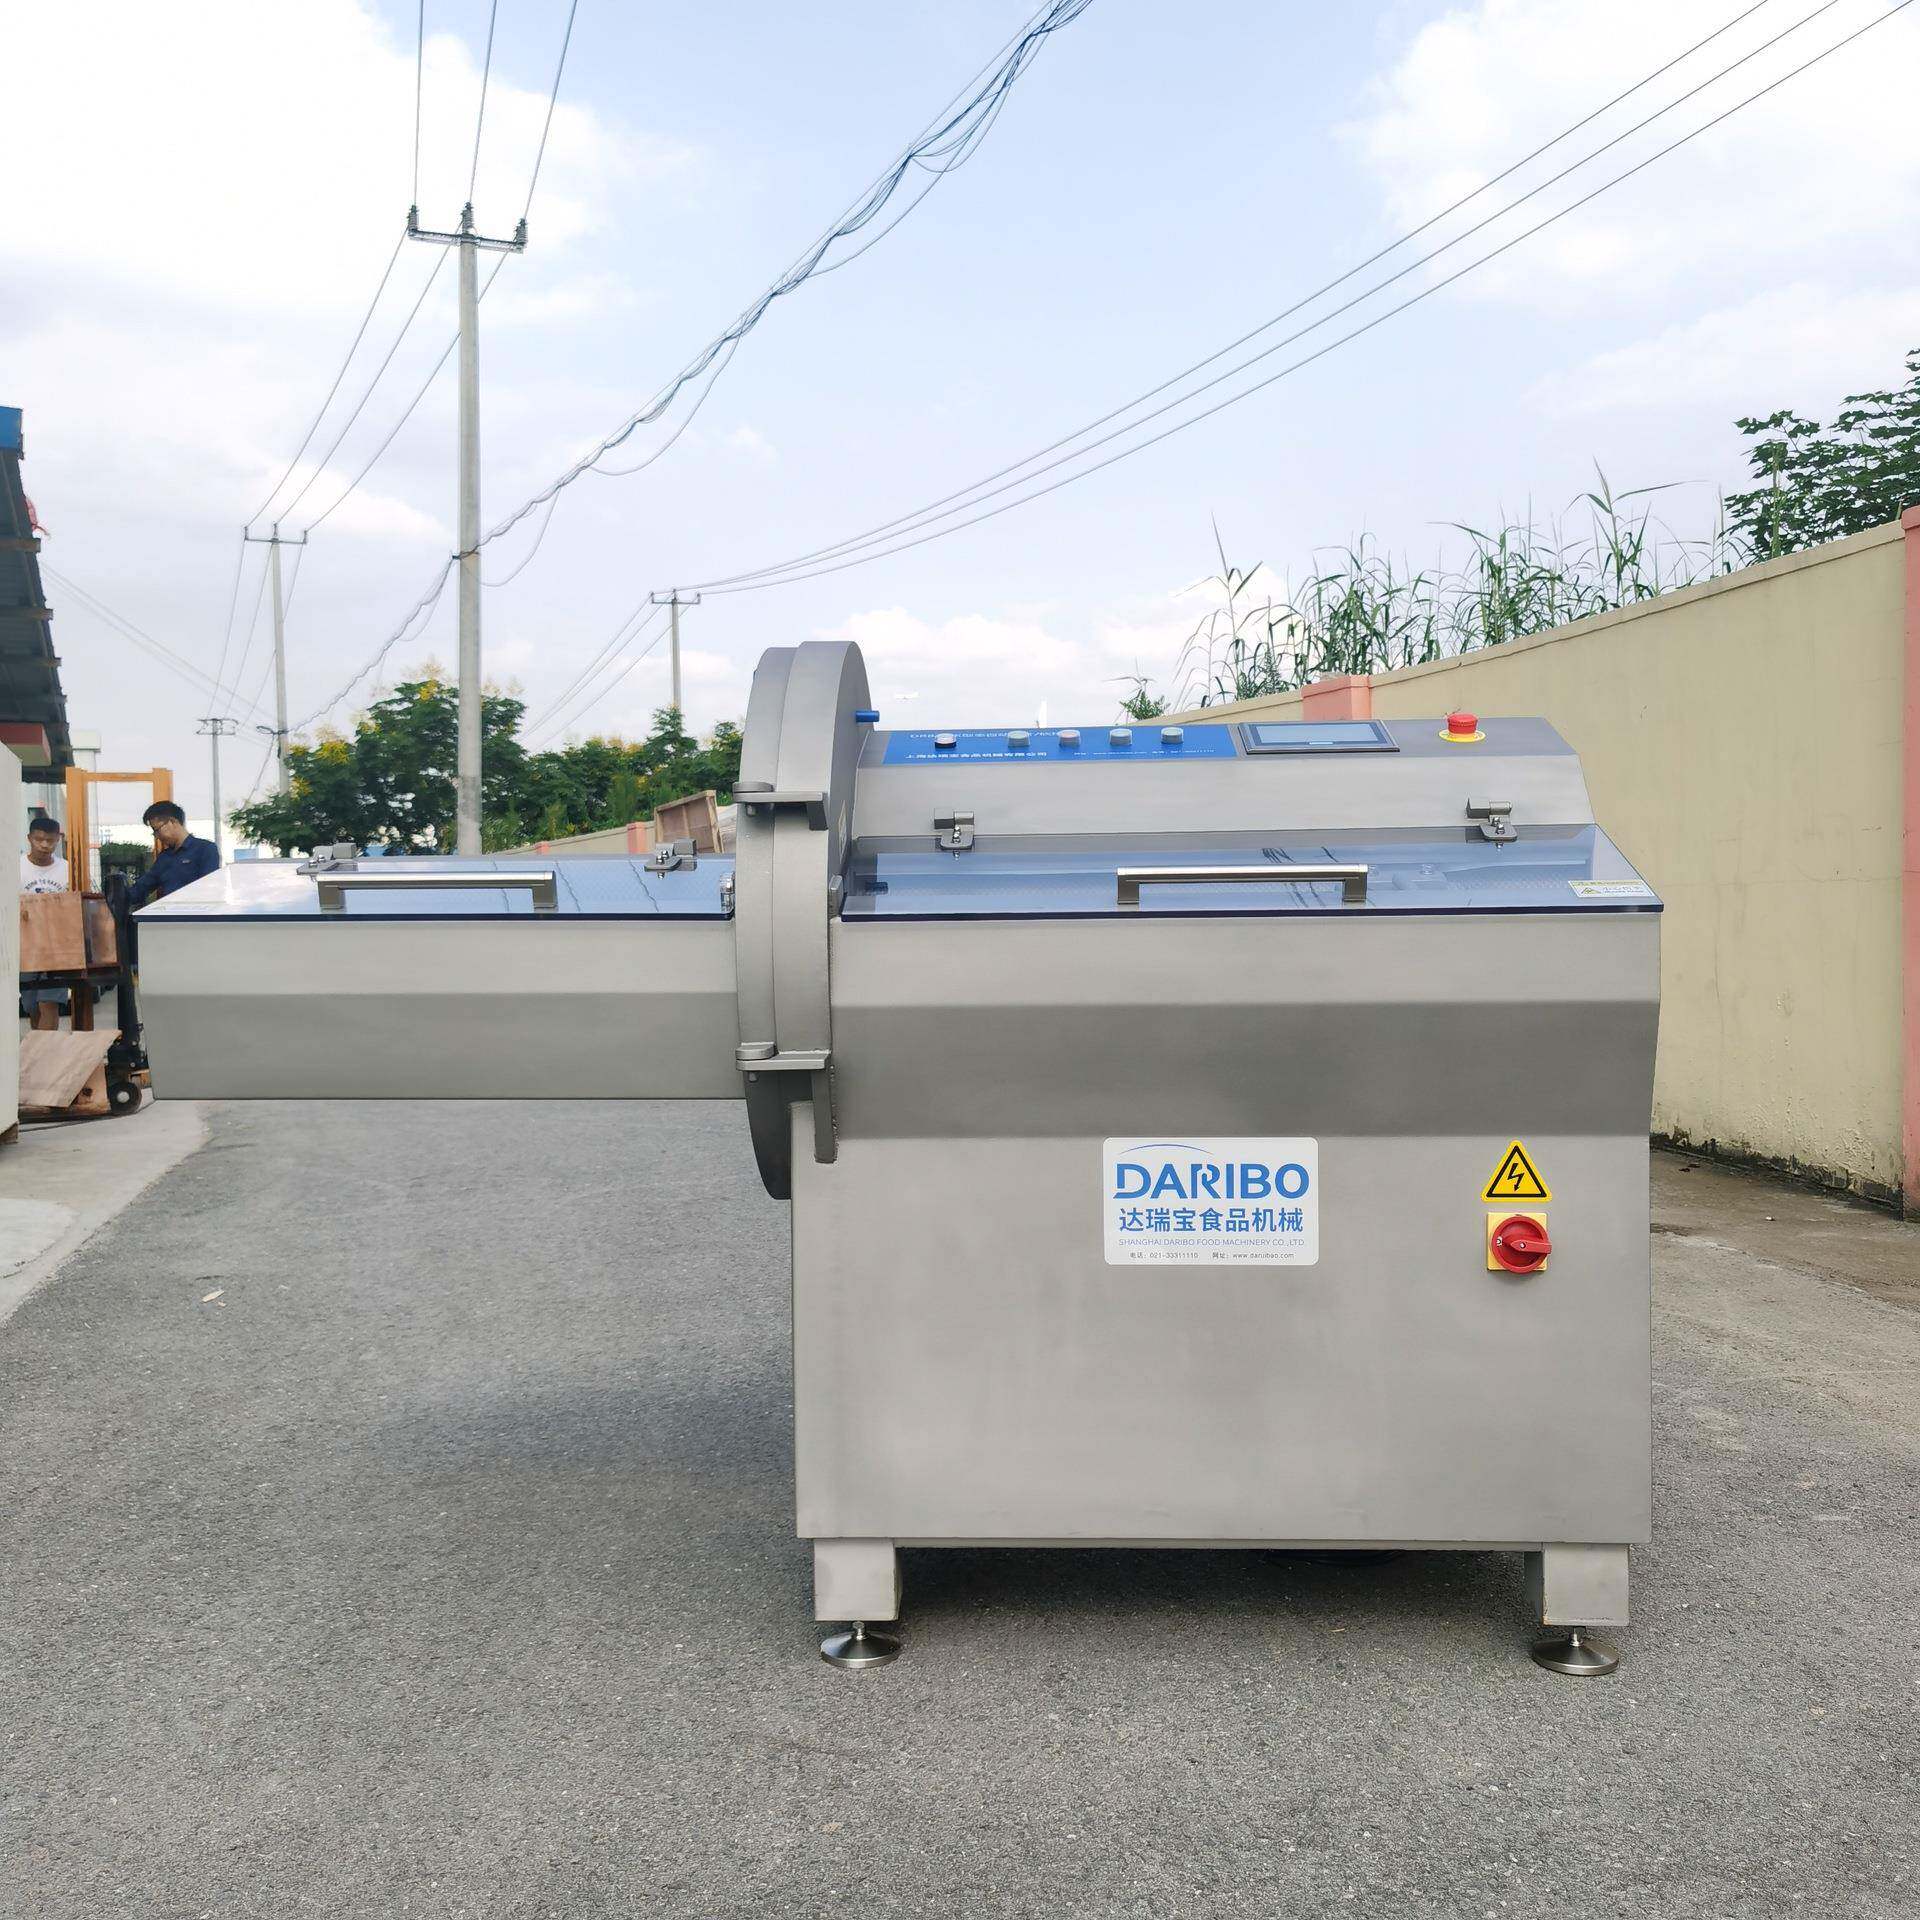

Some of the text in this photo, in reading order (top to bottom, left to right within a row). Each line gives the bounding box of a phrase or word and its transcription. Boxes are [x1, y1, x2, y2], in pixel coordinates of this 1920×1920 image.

[1112, 1163, 1309, 1199] DARIBO
[1118, 1207, 1304, 1233] 达瑞宝食品机械
[1118, 1238, 1161, 1246] SHANGHAI
[1163, 1238, 1195, 1246] DARIBO
[1196, 1238, 1221, 1246] FOOD
[1222, 1238, 1270, 1246] MACHINERY
